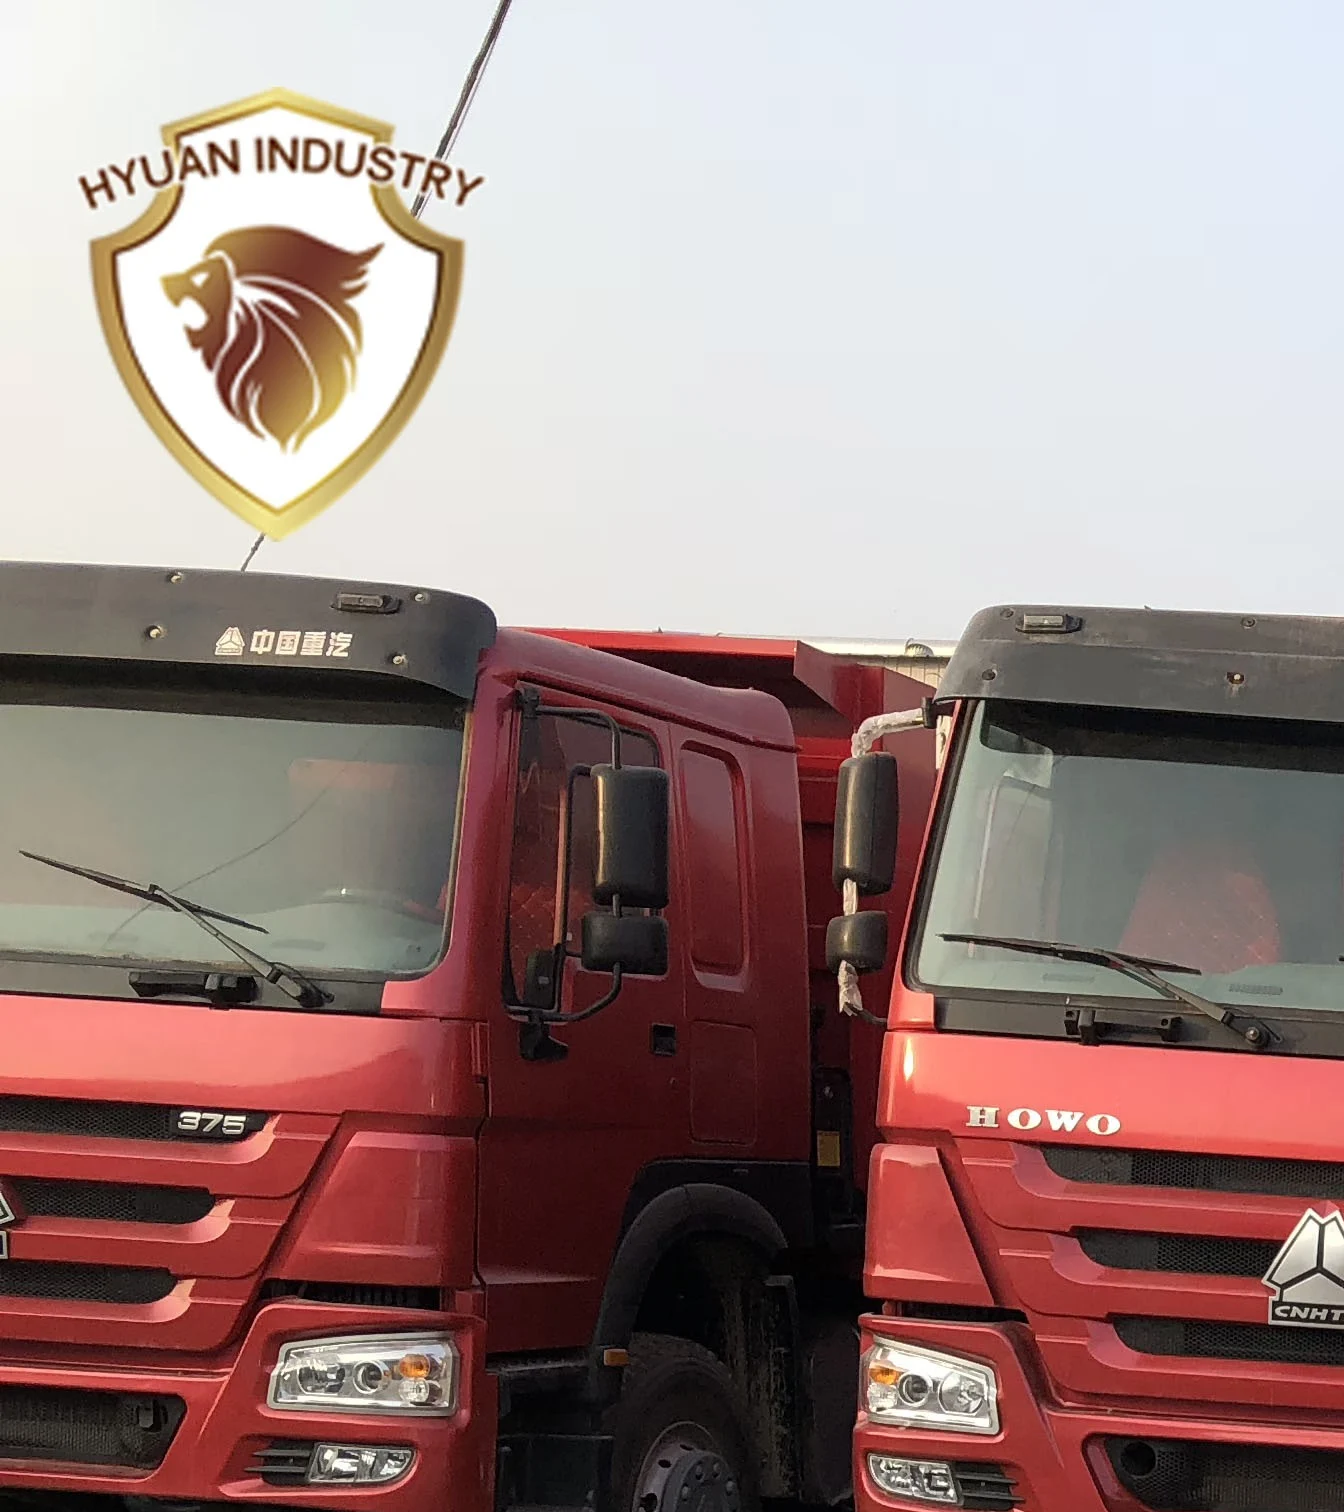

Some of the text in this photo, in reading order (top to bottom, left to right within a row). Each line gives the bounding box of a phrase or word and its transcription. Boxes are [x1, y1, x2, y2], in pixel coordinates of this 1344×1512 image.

[250, 629, 353, 657] 中国重汽
[177, 1111, 247, 1135] 375
[965, 1105, 1121, 1136] HOWO
